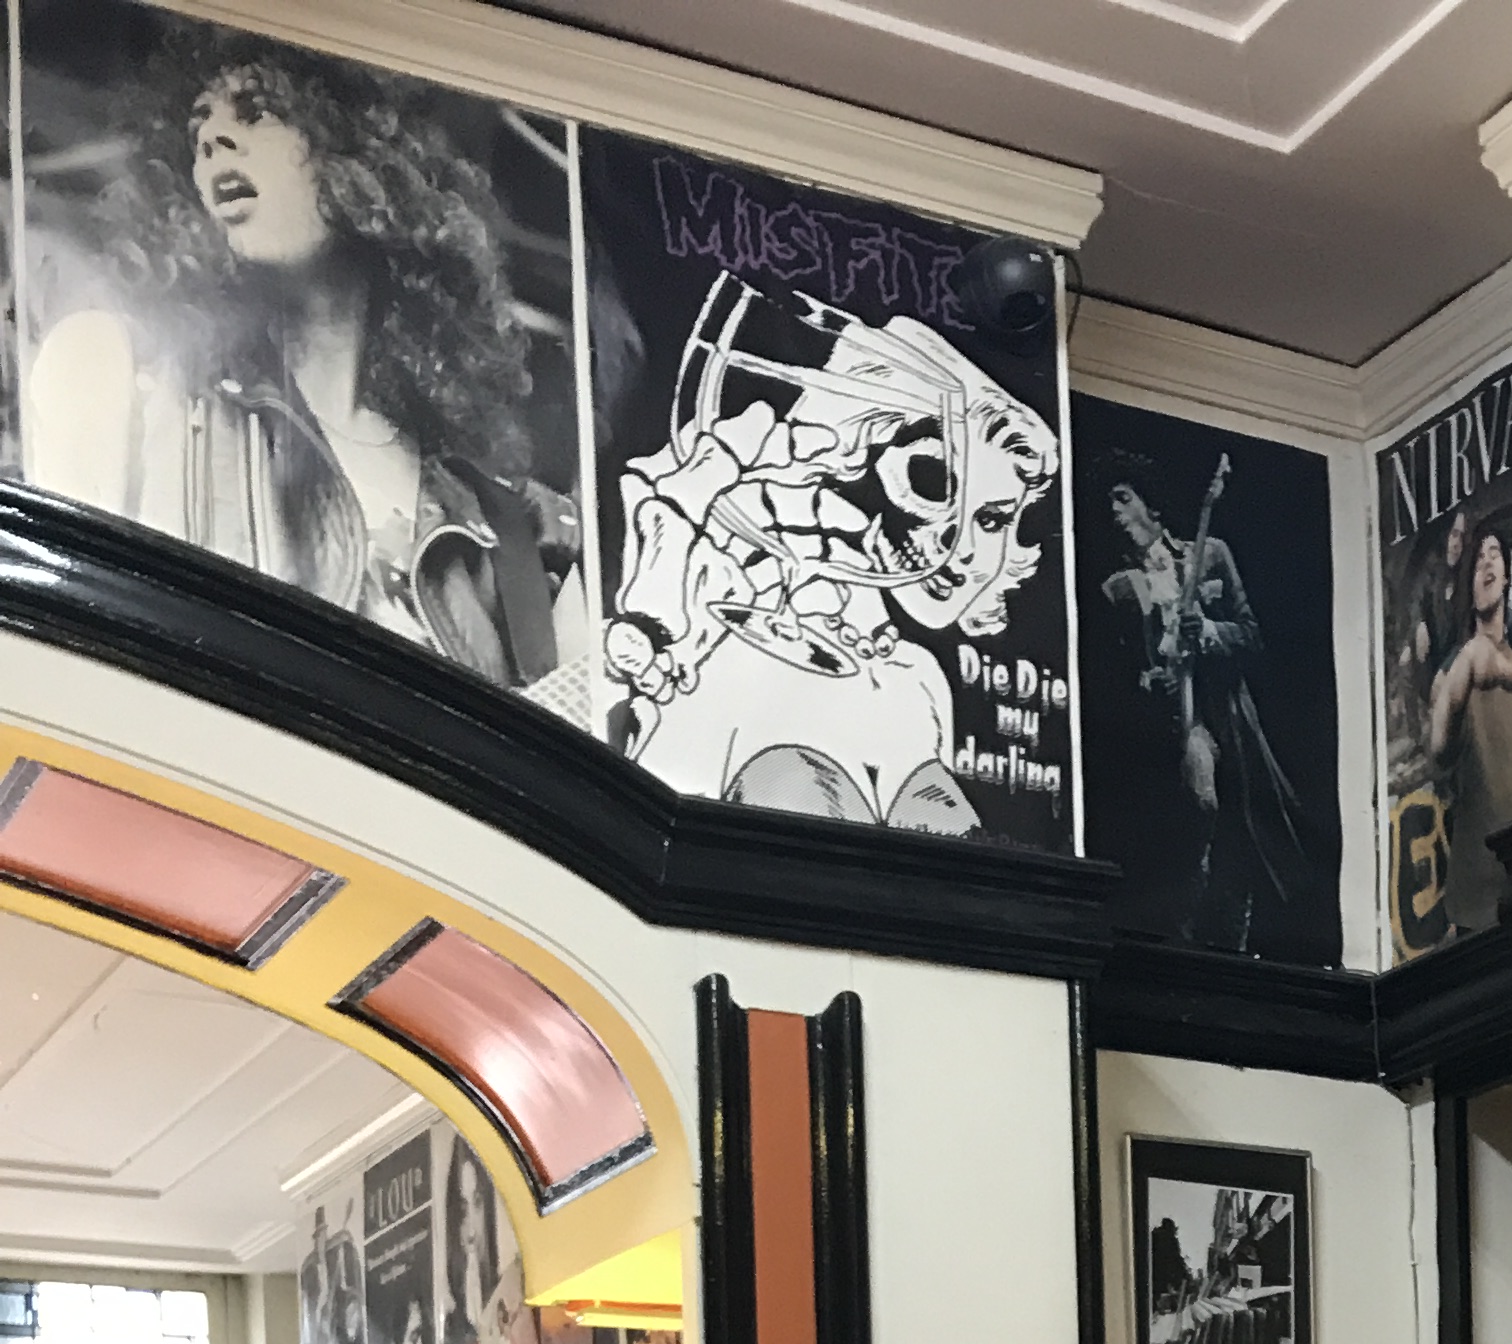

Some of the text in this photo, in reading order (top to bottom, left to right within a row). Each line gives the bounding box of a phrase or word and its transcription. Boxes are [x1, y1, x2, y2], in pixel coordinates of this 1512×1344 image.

[957, 643, 1067, 713] Die Die
[996, 704, 1040, 748] my
[956, 735, 1062, 818] darling
